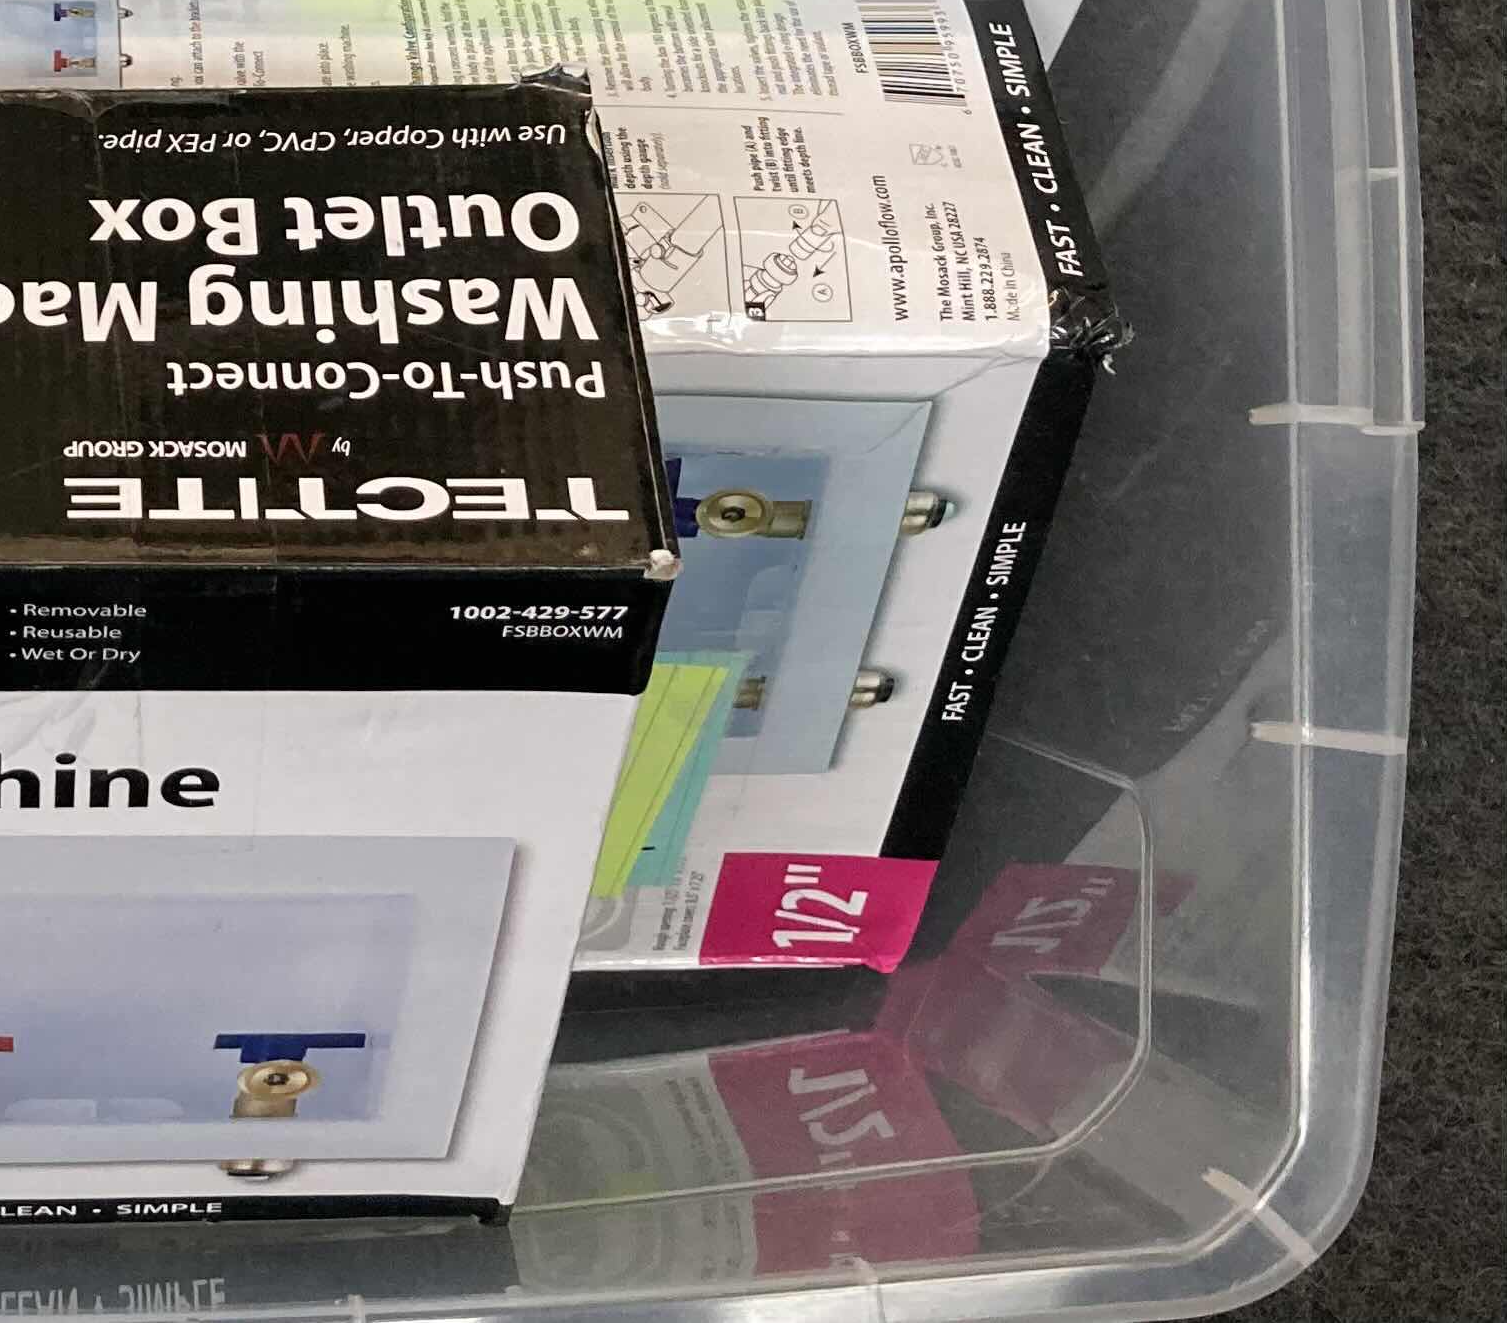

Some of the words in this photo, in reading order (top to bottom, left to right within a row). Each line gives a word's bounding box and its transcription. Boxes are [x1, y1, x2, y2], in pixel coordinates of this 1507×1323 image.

[990, 21, 1033, 99] SIMPLE
[97, 131, 161, 153] pipe.
[165, 134, 217, 153] PEX
[259, 130, 336, 152] CPVC,
[346, 125, 444, 149] Copper,
[452, 124, 512, 145] with
[518, 124, 566, 144] Use
[1019, 122, 1060, 196] CLEAN
[750, 171, 765, 192] Push
[89, 192, 259, 256] Box
[285, 192, 580, 257] Outlet
[942, 201, 960, 228] 28227
[872, 174, 909, 322] www.apolloflow.com
[929, 220, 946, 253] Group,
[951, 229, 966, 250] USA
[955, 250, 967, 266] NC
[1058, 220, 1085, 279] FAST
[936, 255, 952, 297] Mosack
[956, 267, 973, 295] Hill,
[973, 237, 997, 321] 1.888.229.2874
[187, 265, 599, 342] Washing
[940, 298, 953, 322] The
[962, 297, 975, 321] Mint
[168, 361, 607, 402] Push-To-Connect
[63, 439, 143, 458] GROUP
[148, 440, 247, 458] MOSACK
[66, 477, 629, 521] TECTITE
[23, 603, 147, 619] Removable
[449, 605, 629, 622] 1002-429-577
[942, 680, 974, 723] FAST
[962, 605, 998, 664] CLEAN
[987, 520, 1027, 587] SIMPLE
[21, 625, 122, 642] Reusable
[501, 625, 625, 640] FSBBOXWM
[21, 646, 65, 662] Wet
[101, 646, 141, 665] Dry
[772, 864, 869, 949] 1/2"
[116, 1202, 223, 1216] SIMPLE
